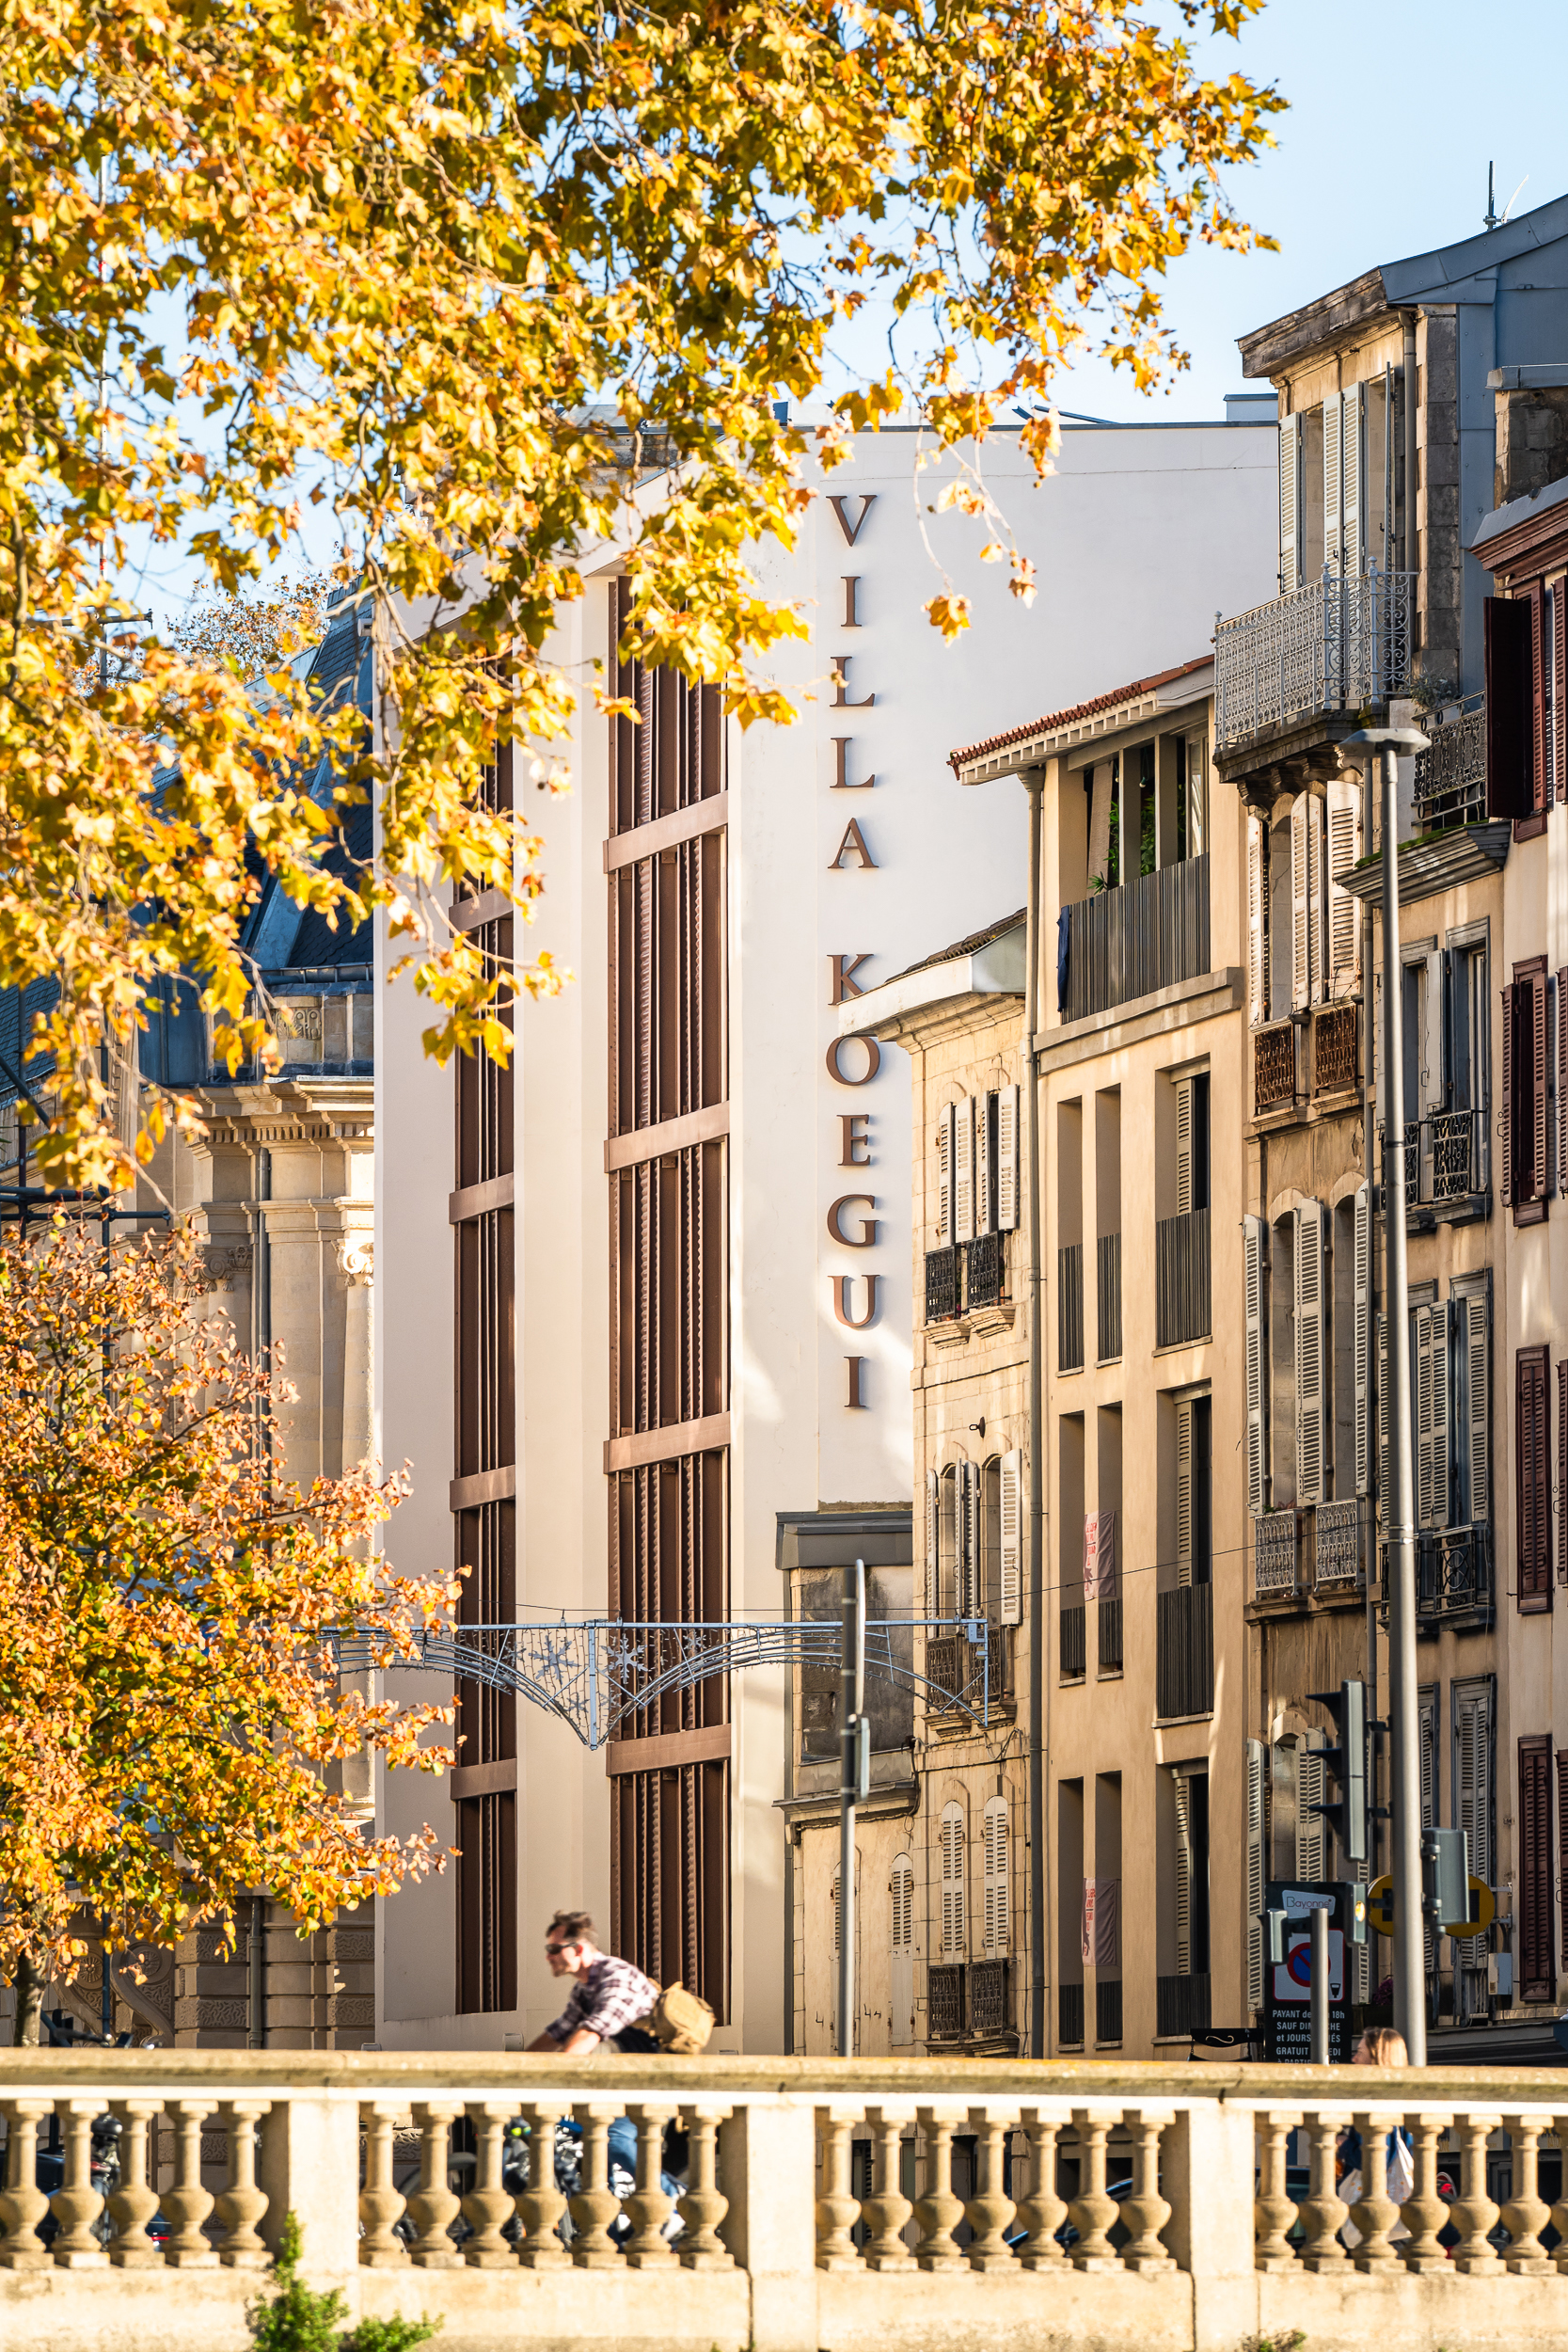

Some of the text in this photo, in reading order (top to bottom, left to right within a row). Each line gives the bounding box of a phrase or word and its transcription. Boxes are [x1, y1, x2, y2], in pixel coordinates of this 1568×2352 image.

[826, 494, 880, 1408] VILLA KOEGUI
[1286, 1896, 1330, 1910] Bayonne
[1272, 2010, 1301, 2018] PAYANT
[1332, 2010, 1345, 2019] 18h
[1276, 2022, 1297, 2030] SAUF
[1276, 2034, 1285, 2042] et
[1286, 2033, 1312, 2042] JOURS
[1275, 2046, 1308, 2056] GRATUIT
